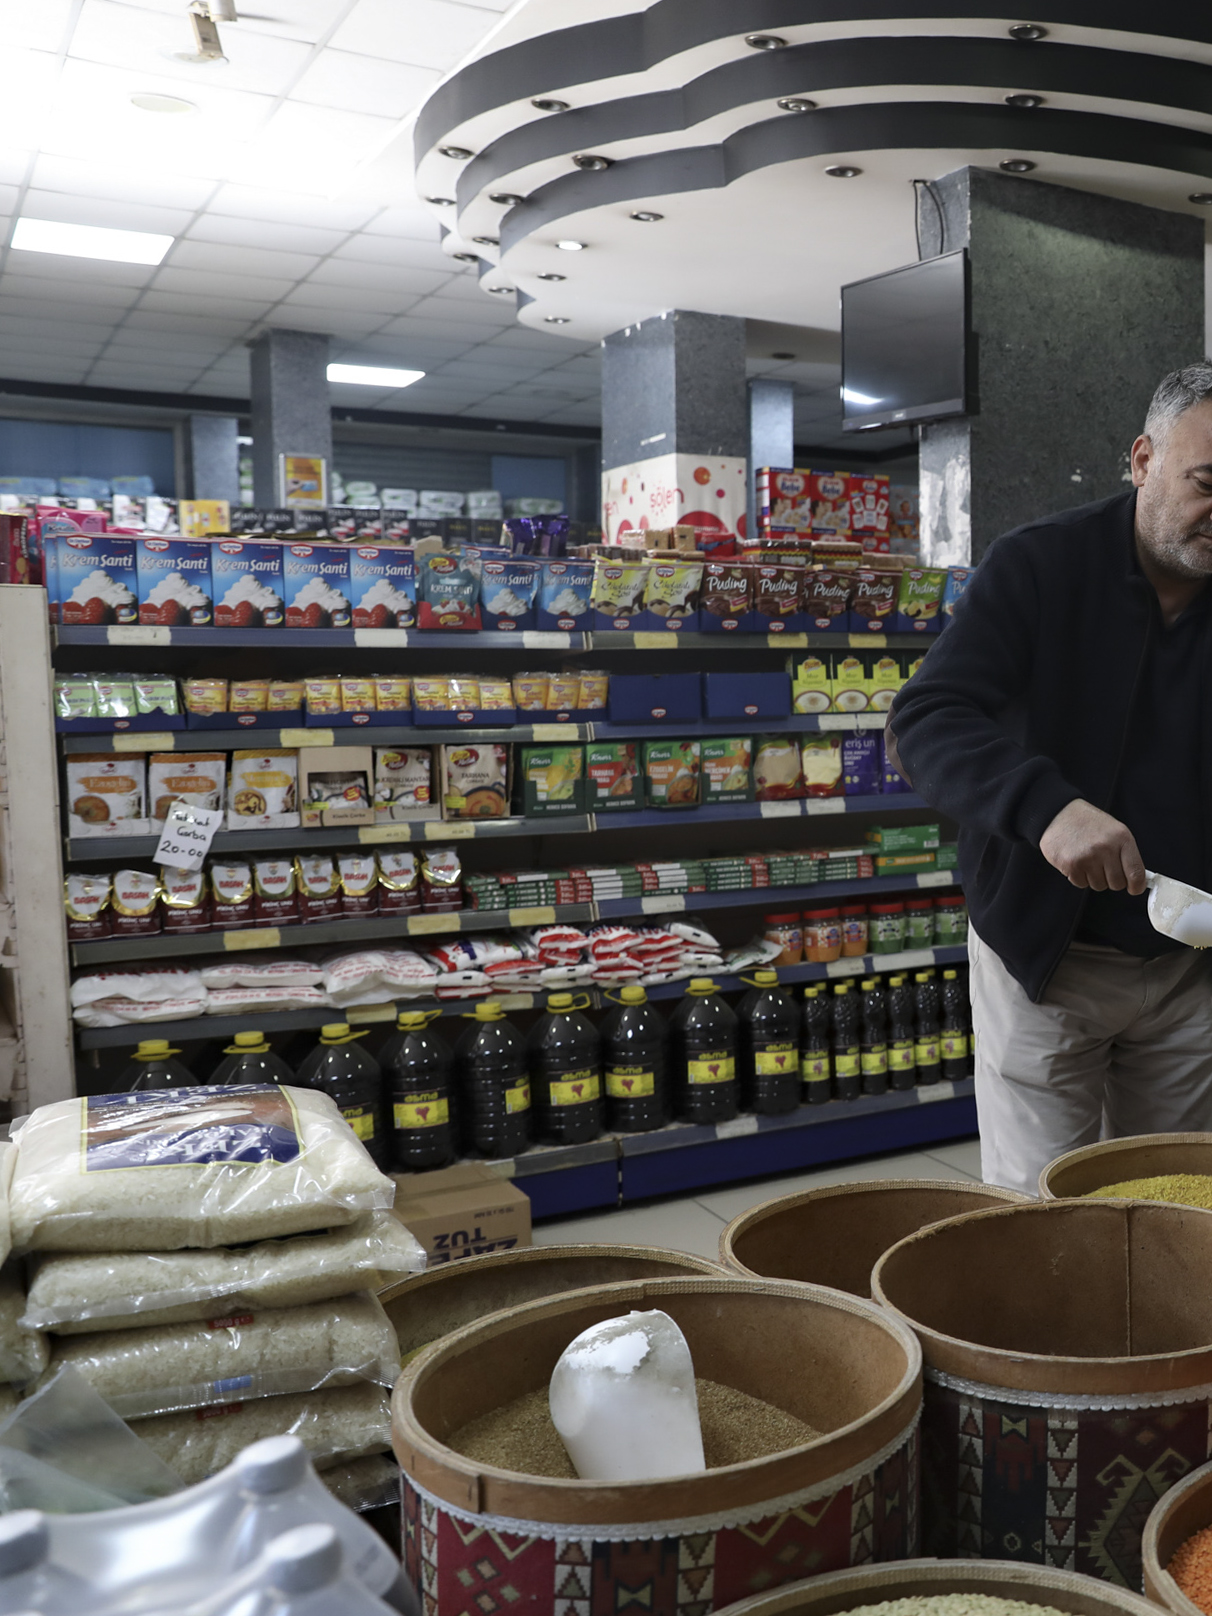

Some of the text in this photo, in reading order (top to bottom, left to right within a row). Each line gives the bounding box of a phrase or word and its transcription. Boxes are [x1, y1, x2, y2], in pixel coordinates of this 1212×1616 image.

[62, 554, 99, 567] Krem
[141, 556, 175, 569] Krem
[215, 559, 249, 572] Krem
[287, 562, 319, 575] Krem
[353, 564, 385, 576] Krem
[706, 576, 747, 593] Puding
[759, 577, 798, 594] Puding
[858, 582, 894, 598] Puding
[908, 581, 940, 597] Puding
[813, 583, 850, 601] Puding
[530, 757, 552, 766] Knorr
[591, 753, 612, 761] Knorr
[650, 751, 671, 759] Knorr
[561, 1069, 591, 1081] asma
[404, 1091, 438, 1103] asma
[433, 1227, 486, 1250] TUZ
